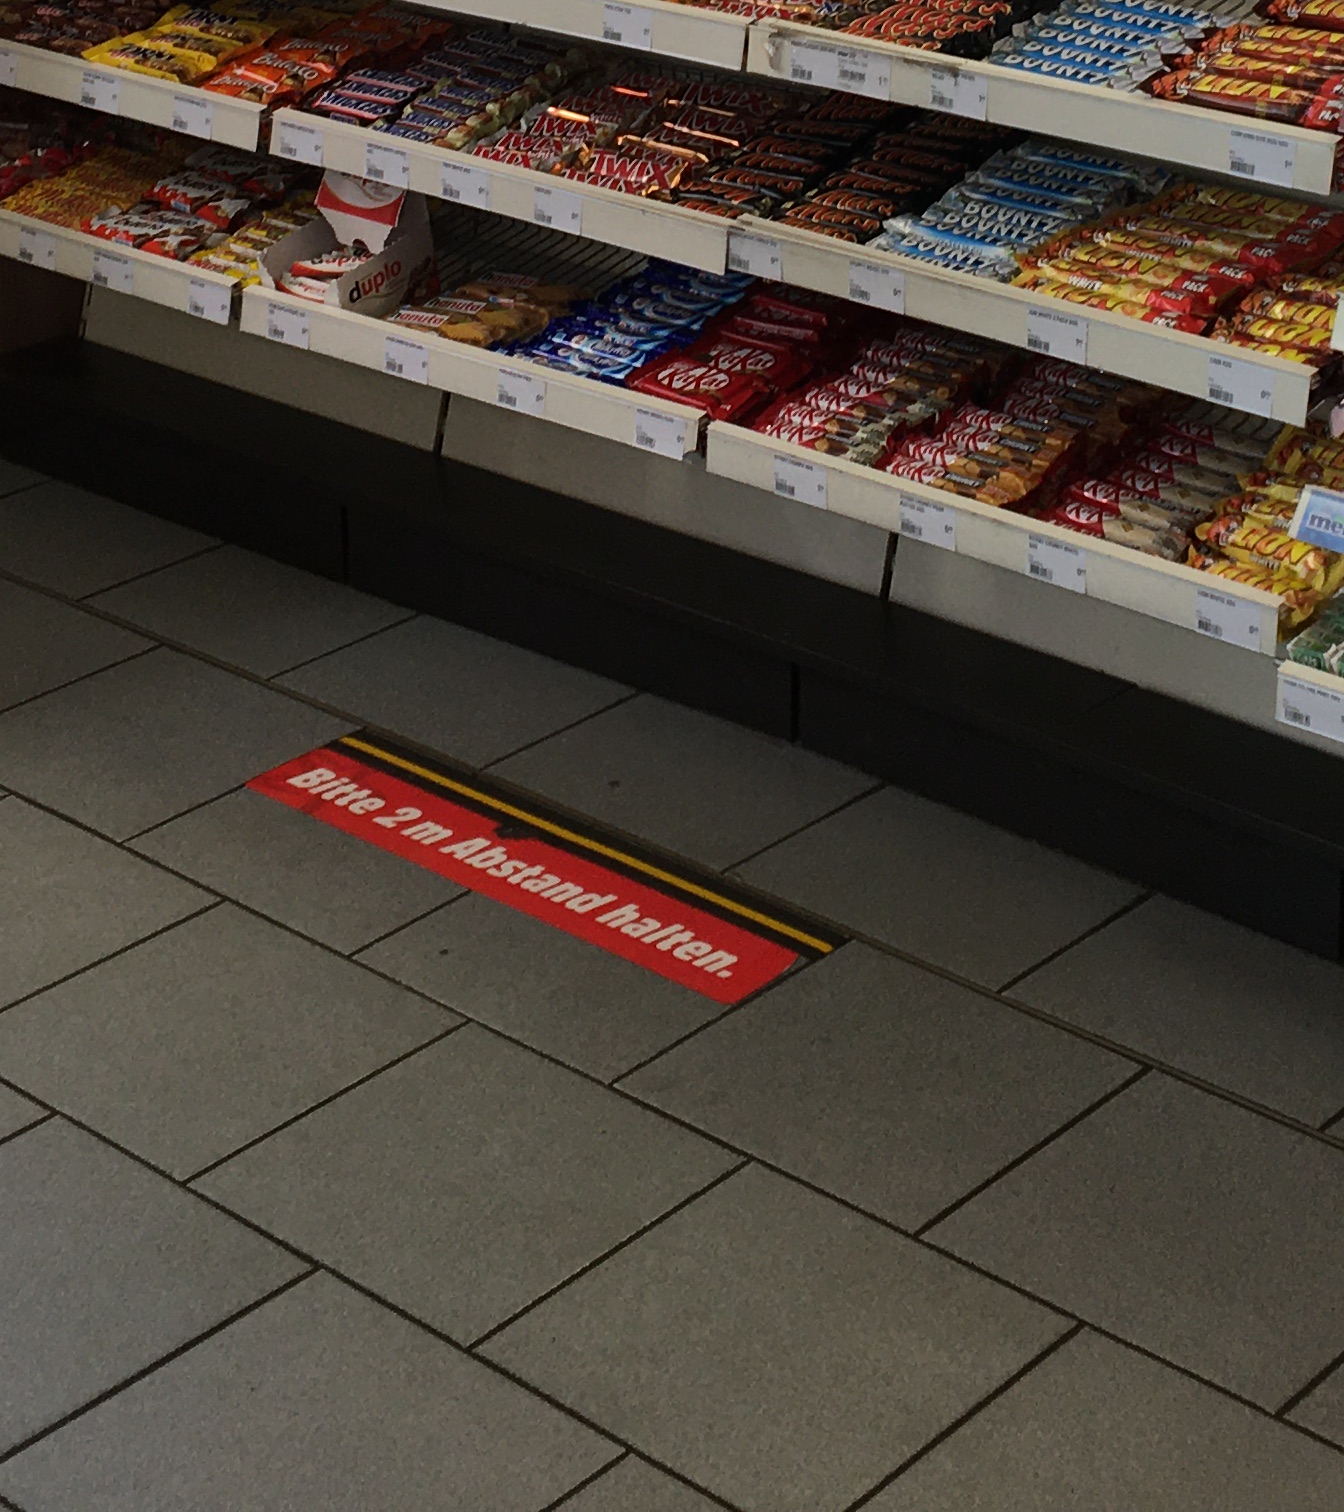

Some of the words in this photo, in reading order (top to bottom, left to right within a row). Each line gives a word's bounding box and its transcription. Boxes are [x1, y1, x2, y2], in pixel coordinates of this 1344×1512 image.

[1197, 76, 1281, 99] LION
[964, 201, 1058, 232] BOUNTY
[349, 258, 403, 304] duplo
[1069, 275, 1103, 291] WHITE
[286, 766, 385, 816] Bitte
[372, 806, 423, 829] 2
[399, 820, 454, 846] m
[437, 835, 618, 916] Abstand
[595, 904, 740, 981] halten.
